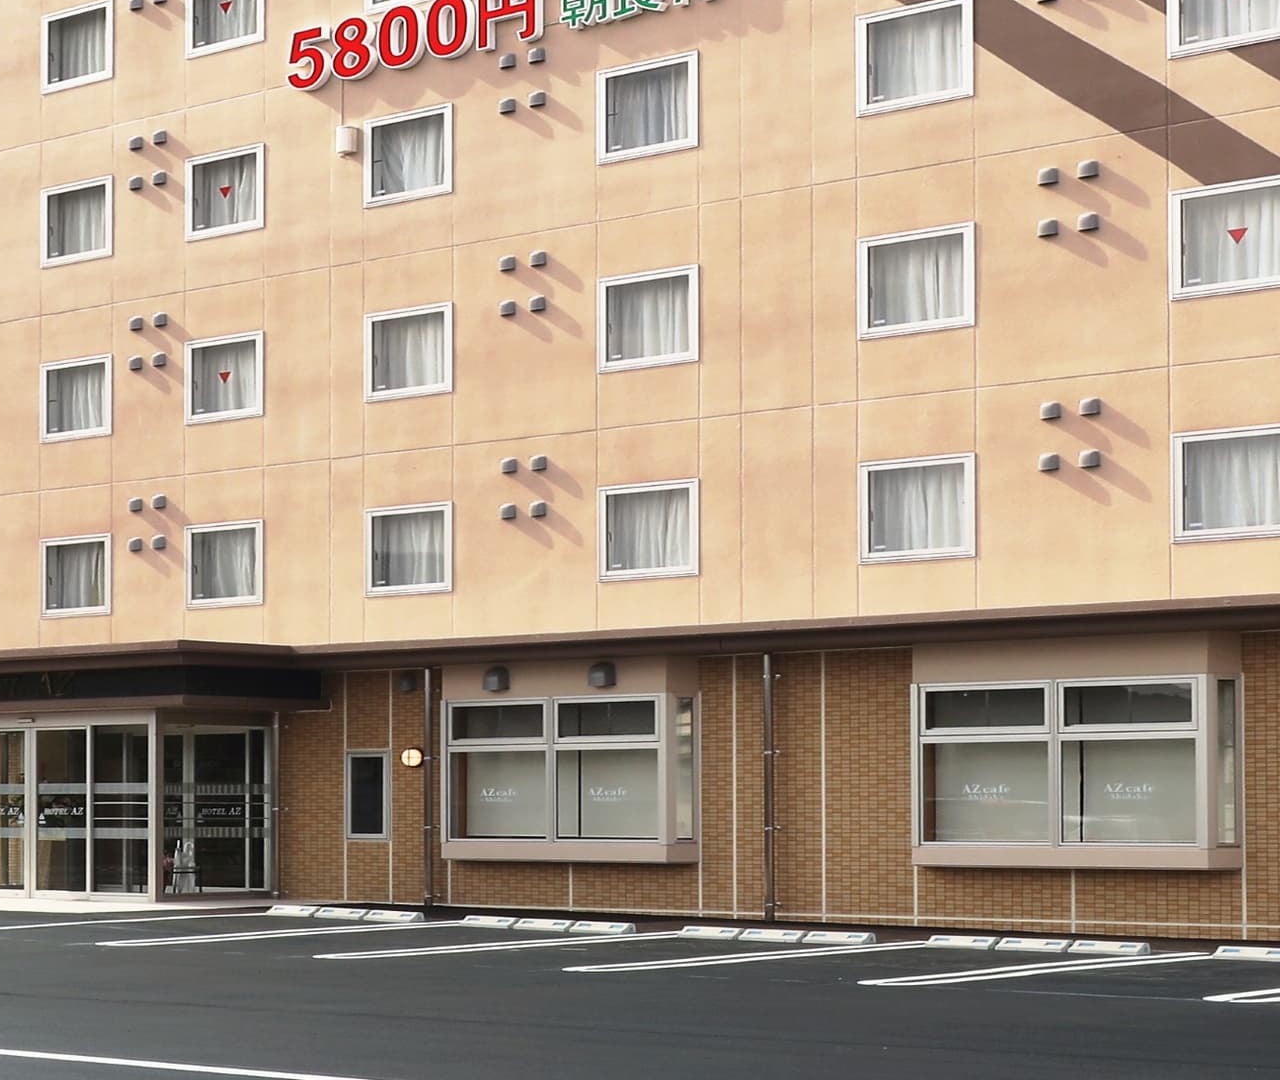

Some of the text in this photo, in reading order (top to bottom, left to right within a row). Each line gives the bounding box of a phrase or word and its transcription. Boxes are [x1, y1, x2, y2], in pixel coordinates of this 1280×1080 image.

[961, 784, 982, 793] AZ
[1104, 783, 1124, 793] AZ
[70, 807, 84, 815] AZ
